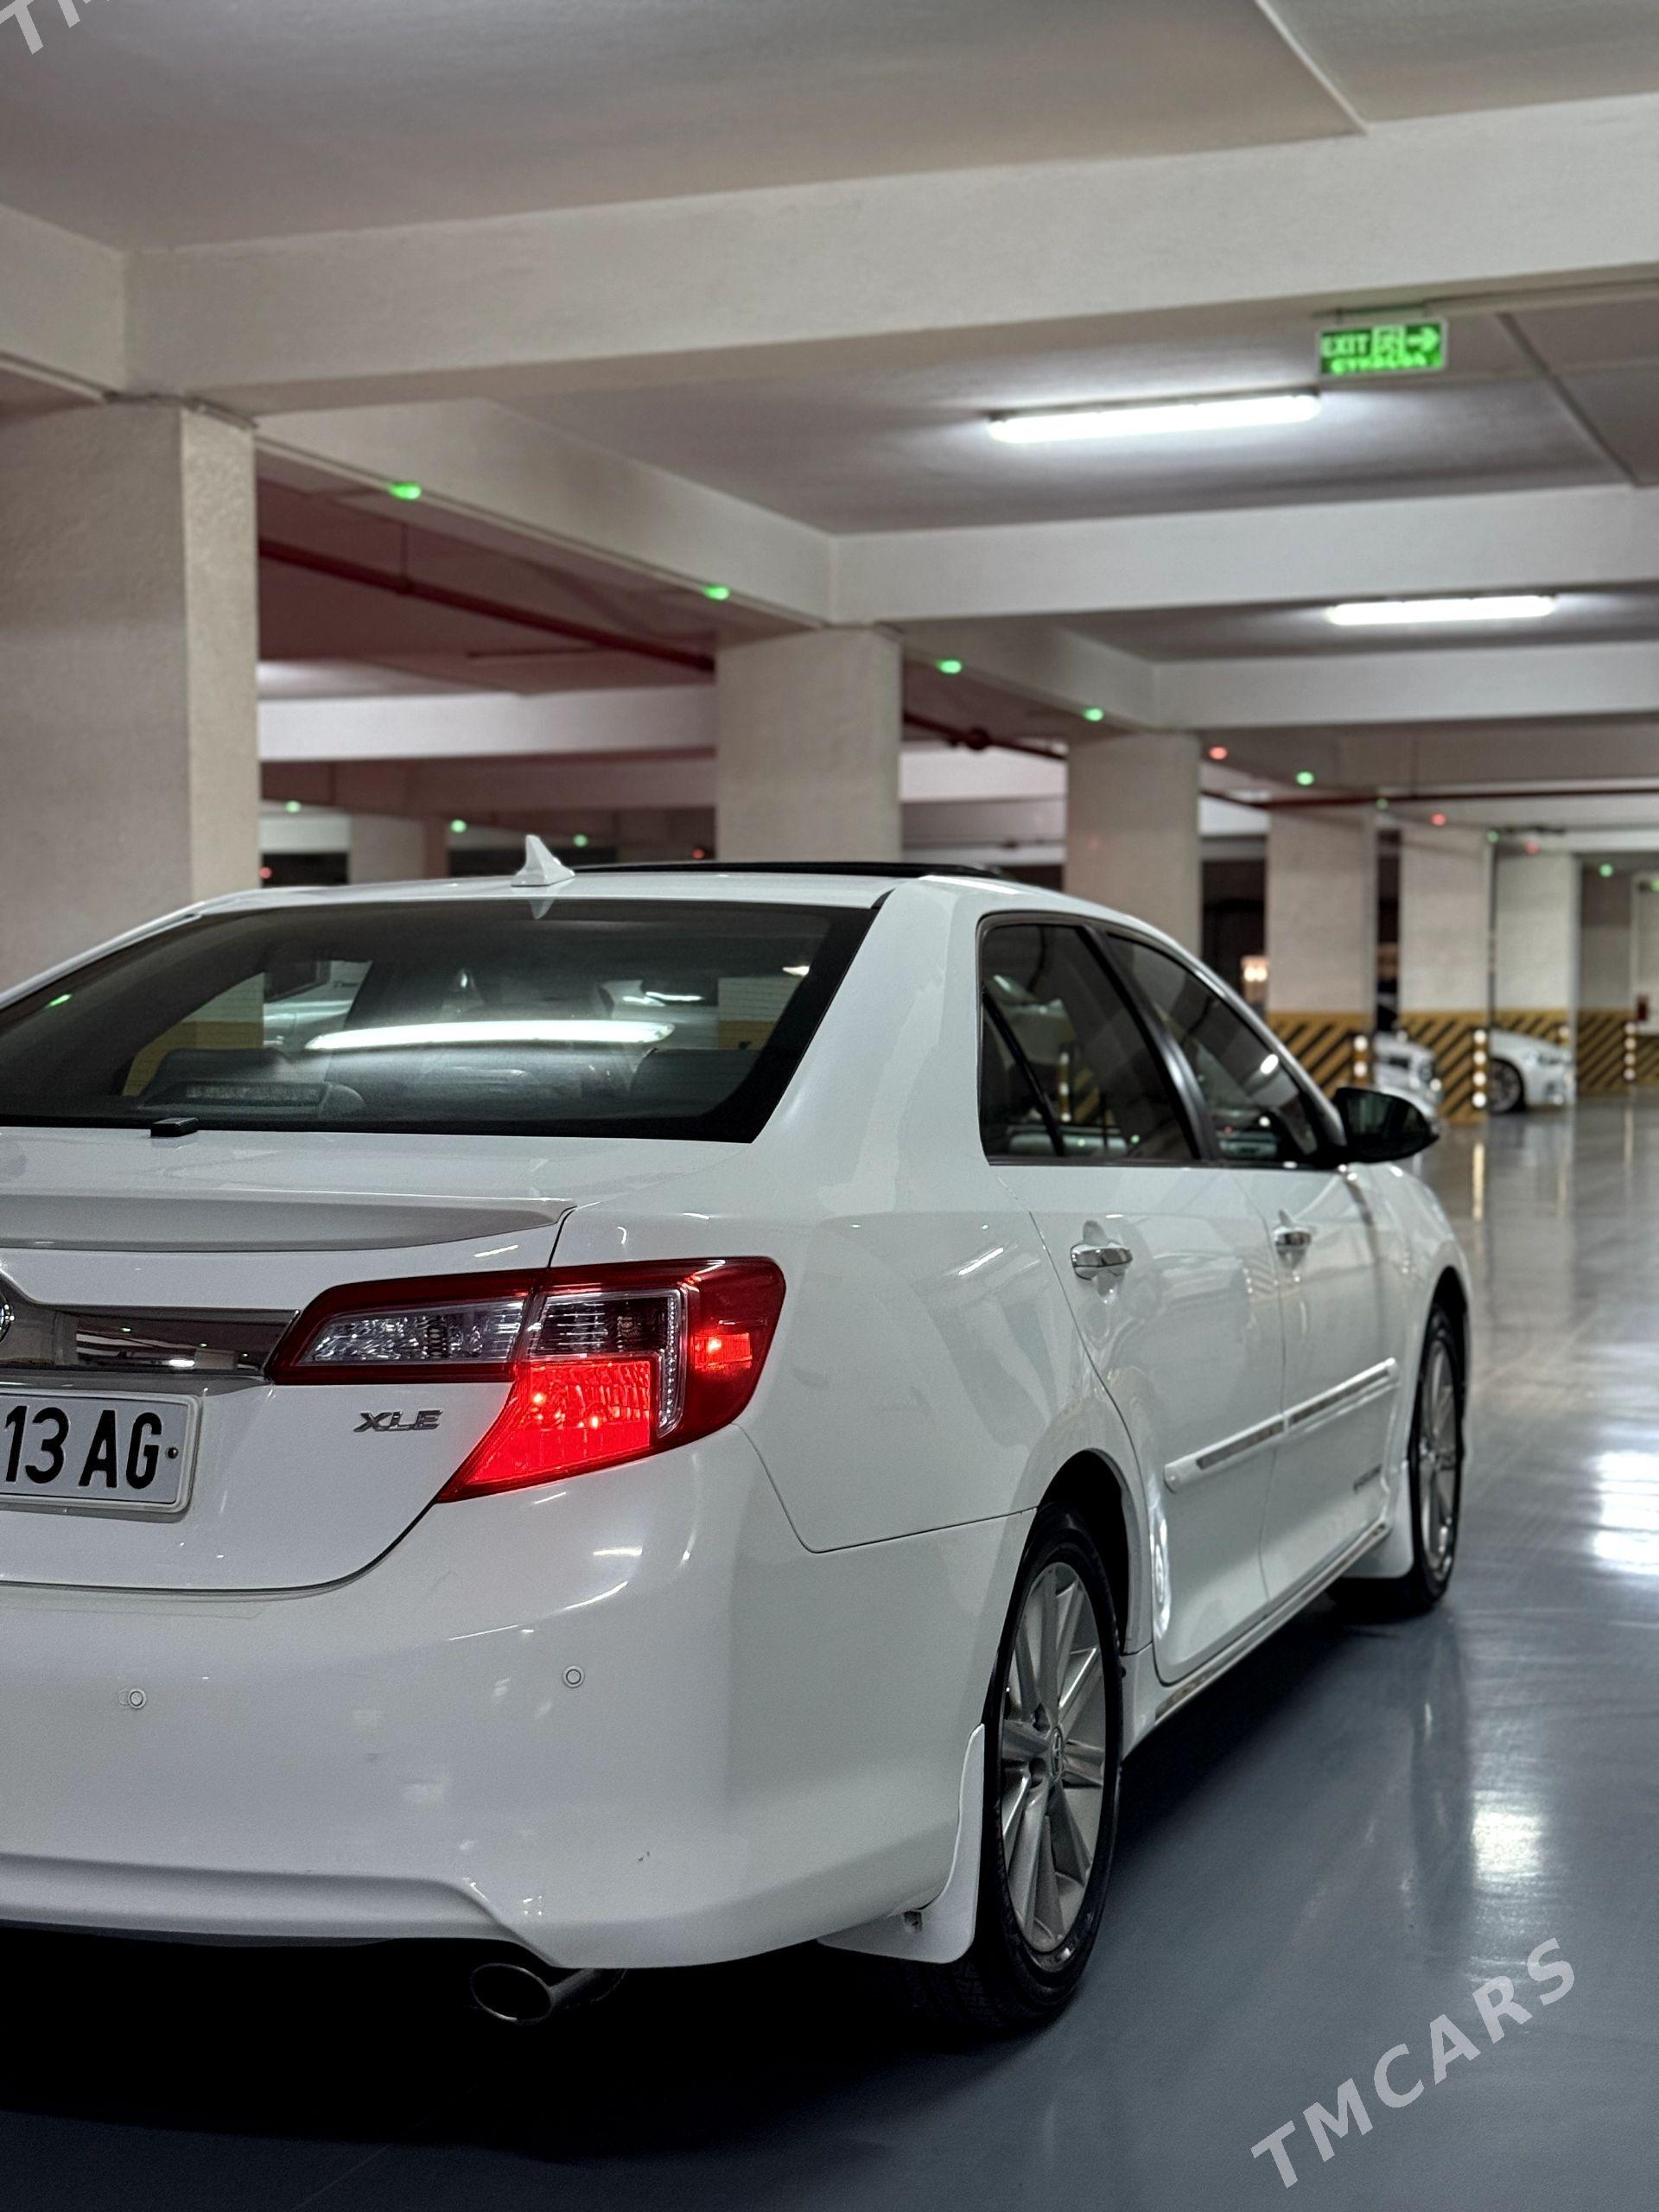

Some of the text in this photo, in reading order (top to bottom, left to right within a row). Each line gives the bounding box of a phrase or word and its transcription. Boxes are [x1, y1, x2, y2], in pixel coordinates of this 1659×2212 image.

[5, 1406, 162, 1490] 13 AG
[353, 1409, 443, 1433] XLE
